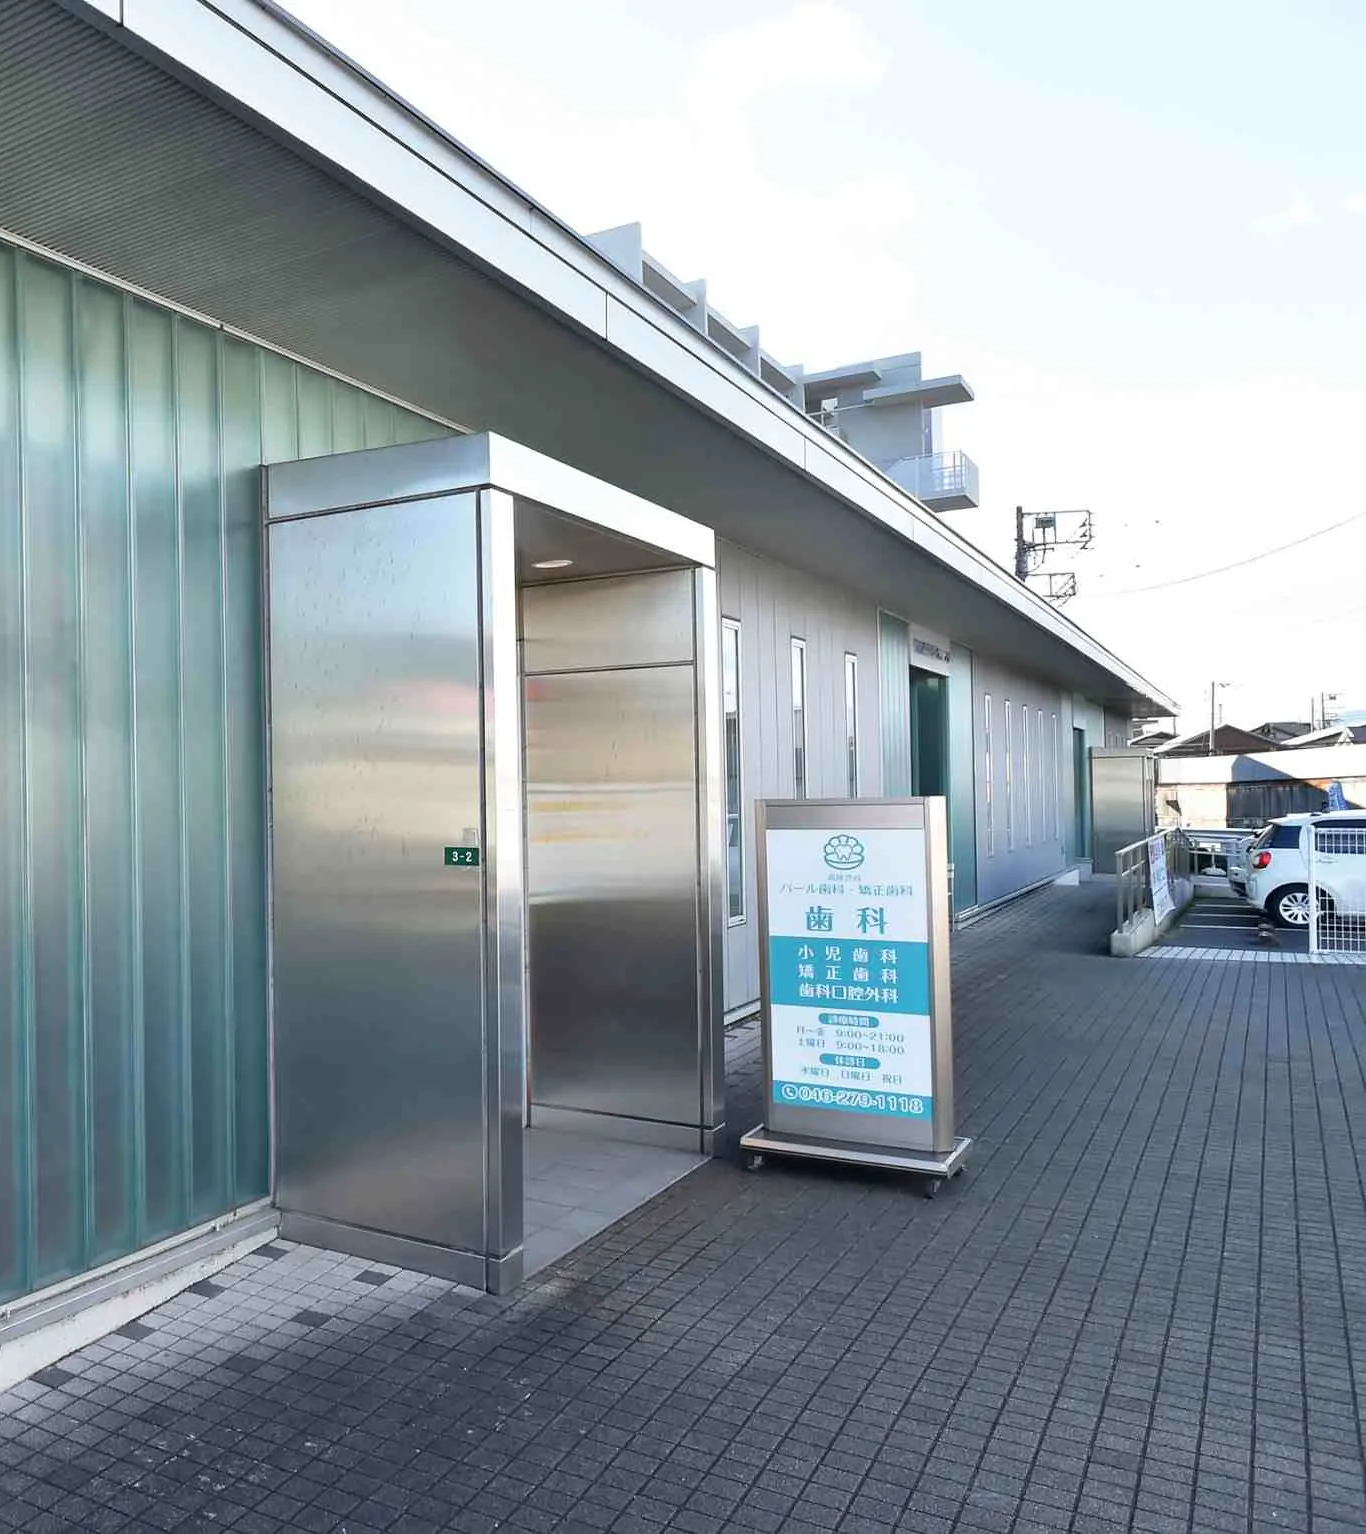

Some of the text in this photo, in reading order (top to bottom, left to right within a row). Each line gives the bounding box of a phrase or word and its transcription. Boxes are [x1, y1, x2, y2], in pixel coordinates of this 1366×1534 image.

[452, 851, 472, 862] 3-2
[799, 983, 898, 1004] 歯科口腔外科
[800, 1087, 923, 1113] 046-279-1118
